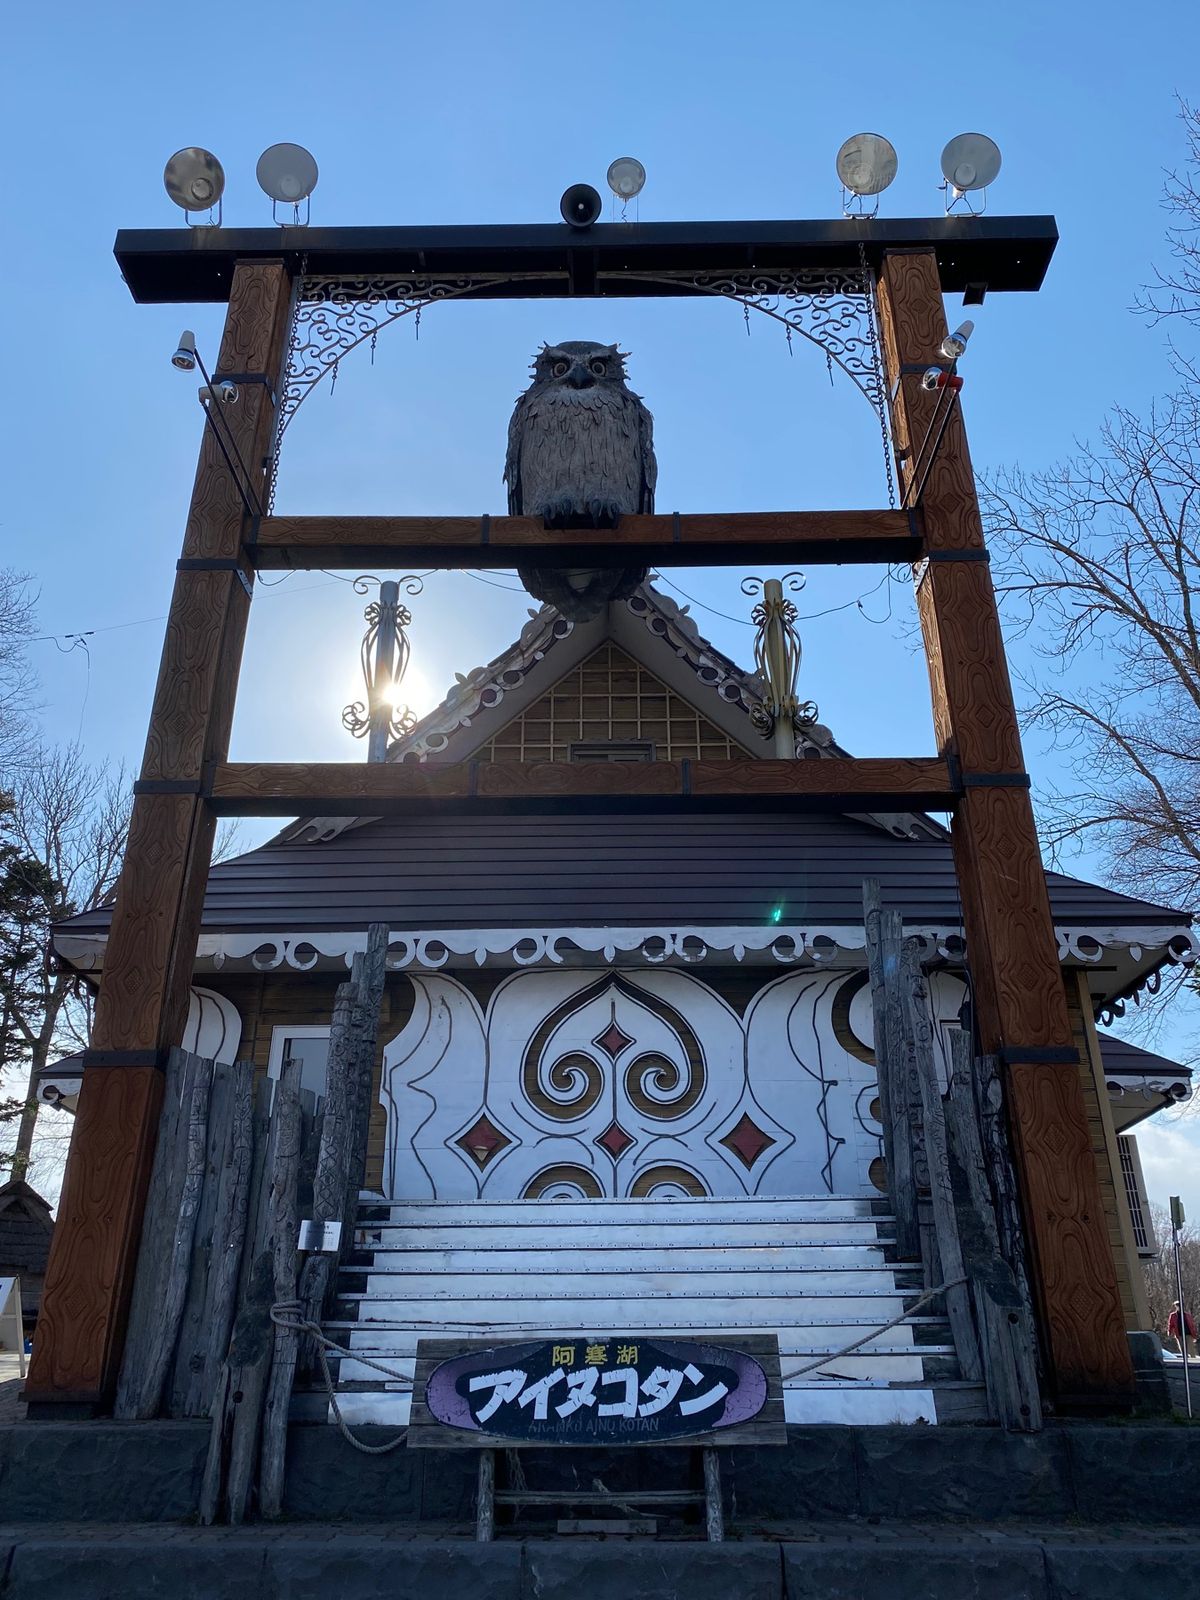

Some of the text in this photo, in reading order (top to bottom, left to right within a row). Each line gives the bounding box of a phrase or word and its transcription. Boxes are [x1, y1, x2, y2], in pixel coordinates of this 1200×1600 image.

[551, 1345, 640, 1367] 阿寒湖
[468, 1362, 729, 1424] アイヌコタン
[585, 1418, 616, 1433] AINU
[619, 1417, 660, 1432] KOTAN
